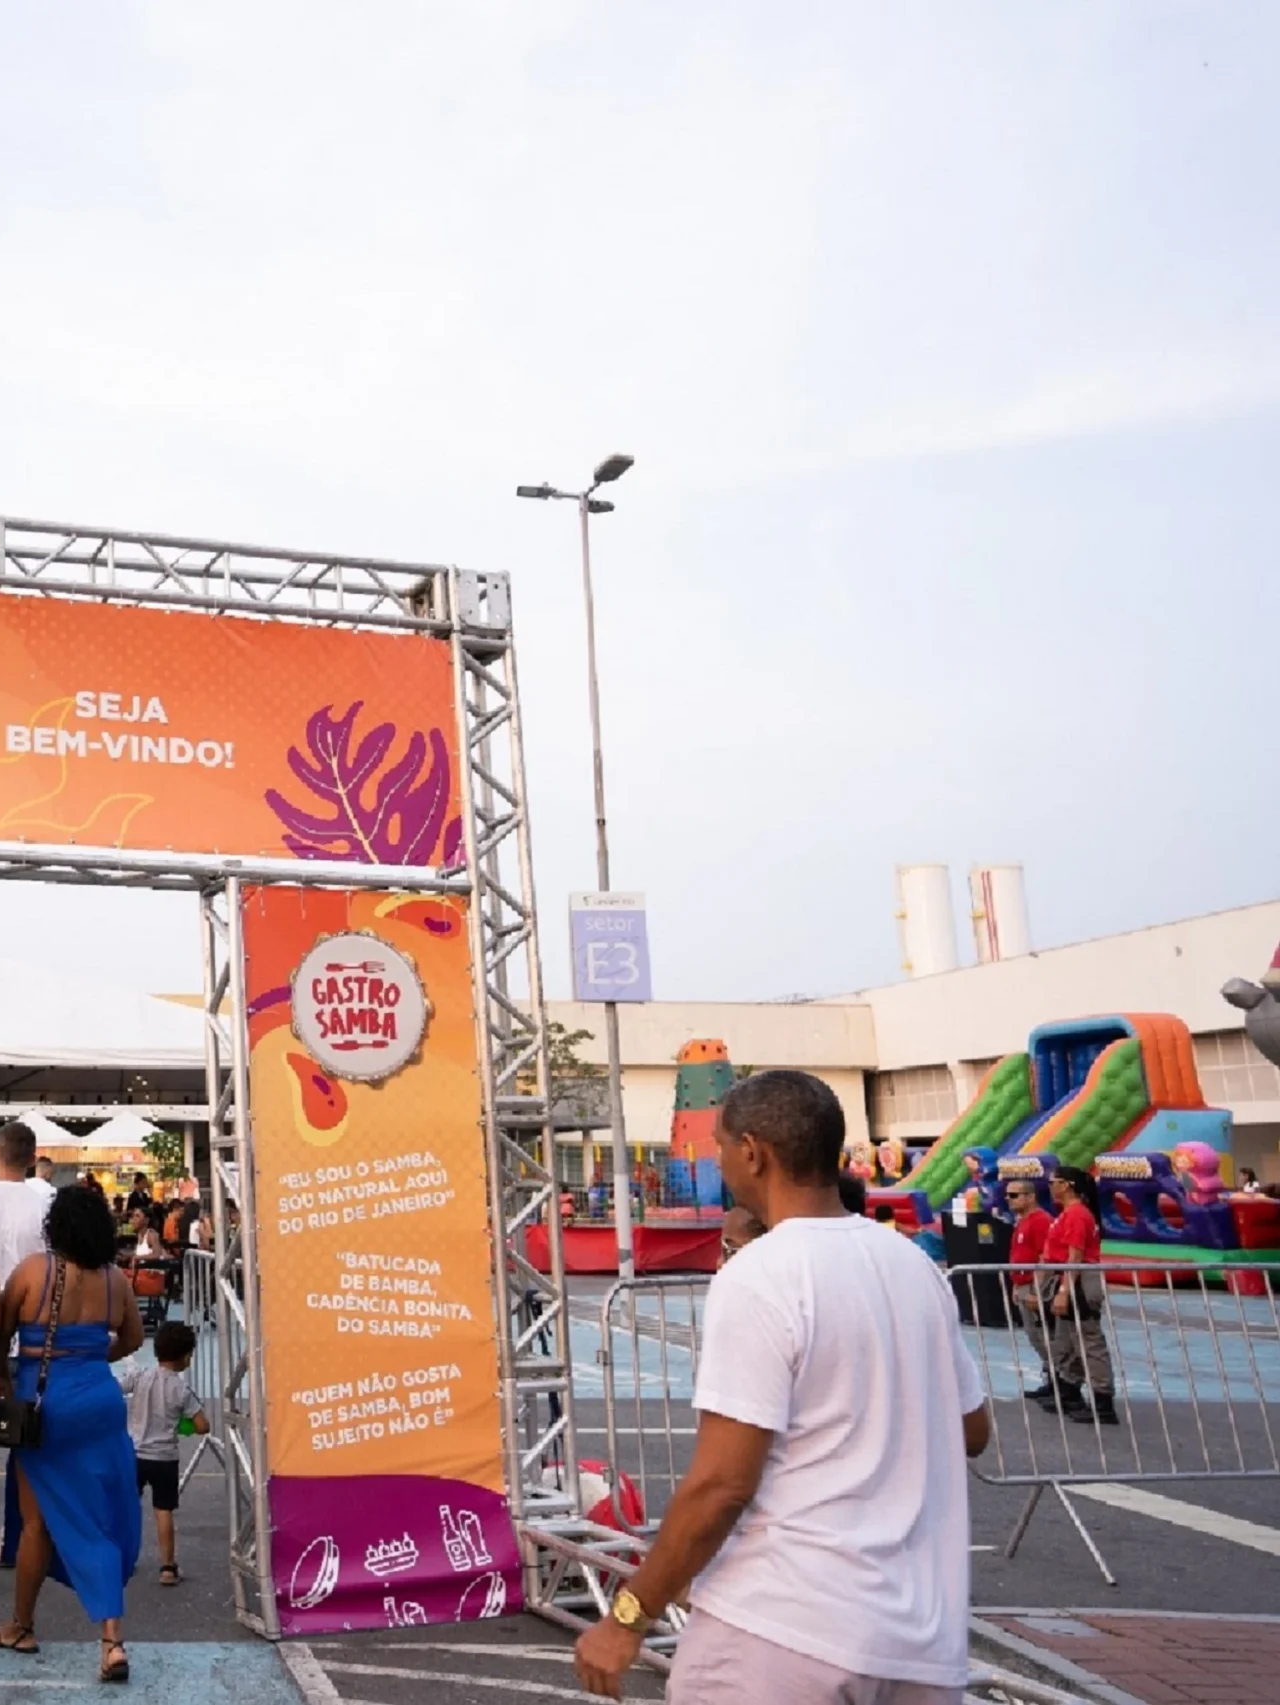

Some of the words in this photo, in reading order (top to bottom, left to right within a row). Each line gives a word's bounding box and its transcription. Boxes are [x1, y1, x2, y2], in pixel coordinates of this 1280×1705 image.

[75, 691, 168, 725] SEJA
[5, 724, 235, 768] BEM-VINDO!
[585, 916, 635, 931] setor
[587, 942, 640, 985] E3
[312, 976, 401, 1008] GASTRO
[315, 1008, 397, 1040] SAMBA
[316, 1164, 352, 1185] SOU
[356, 1161, 368, 1175] O
[373, 1151, 442, 1173] SAMBA,
[278, 1190, 313, 1213] SOU
[319, 1177, 400, 1206] NATURAL
[404, 1170, 447, 1190] AQUI
[278, 1217, 304, 1235] DO
[308, 1211, 339, 1229] RIO
[343, 1207, 367, 1223] DE
[337, 1252, 441, 1275] “BATUCADA
[340, 1274, 365, 1290] DE
[368, 1275, 438, 1298] BAMBA,
[306, 1291, 399, 1315] CADÊNCIA
[404, 1300, 471, 1321] BONITA
[337, 1316, 364, 1333] DO
[358, 1372, 397, 1395] NÃO
[402, 1364, 461, 1387] GOSTA
[309, 1410, 335, 1428] DE
[337, 1401, 405, 1424] SAMBA,
[409, 1388, 451, 1411] BOM
[312, 1425, 385, 1451] SUJEITO
[389, 1411, 430, 1436] NÃO
